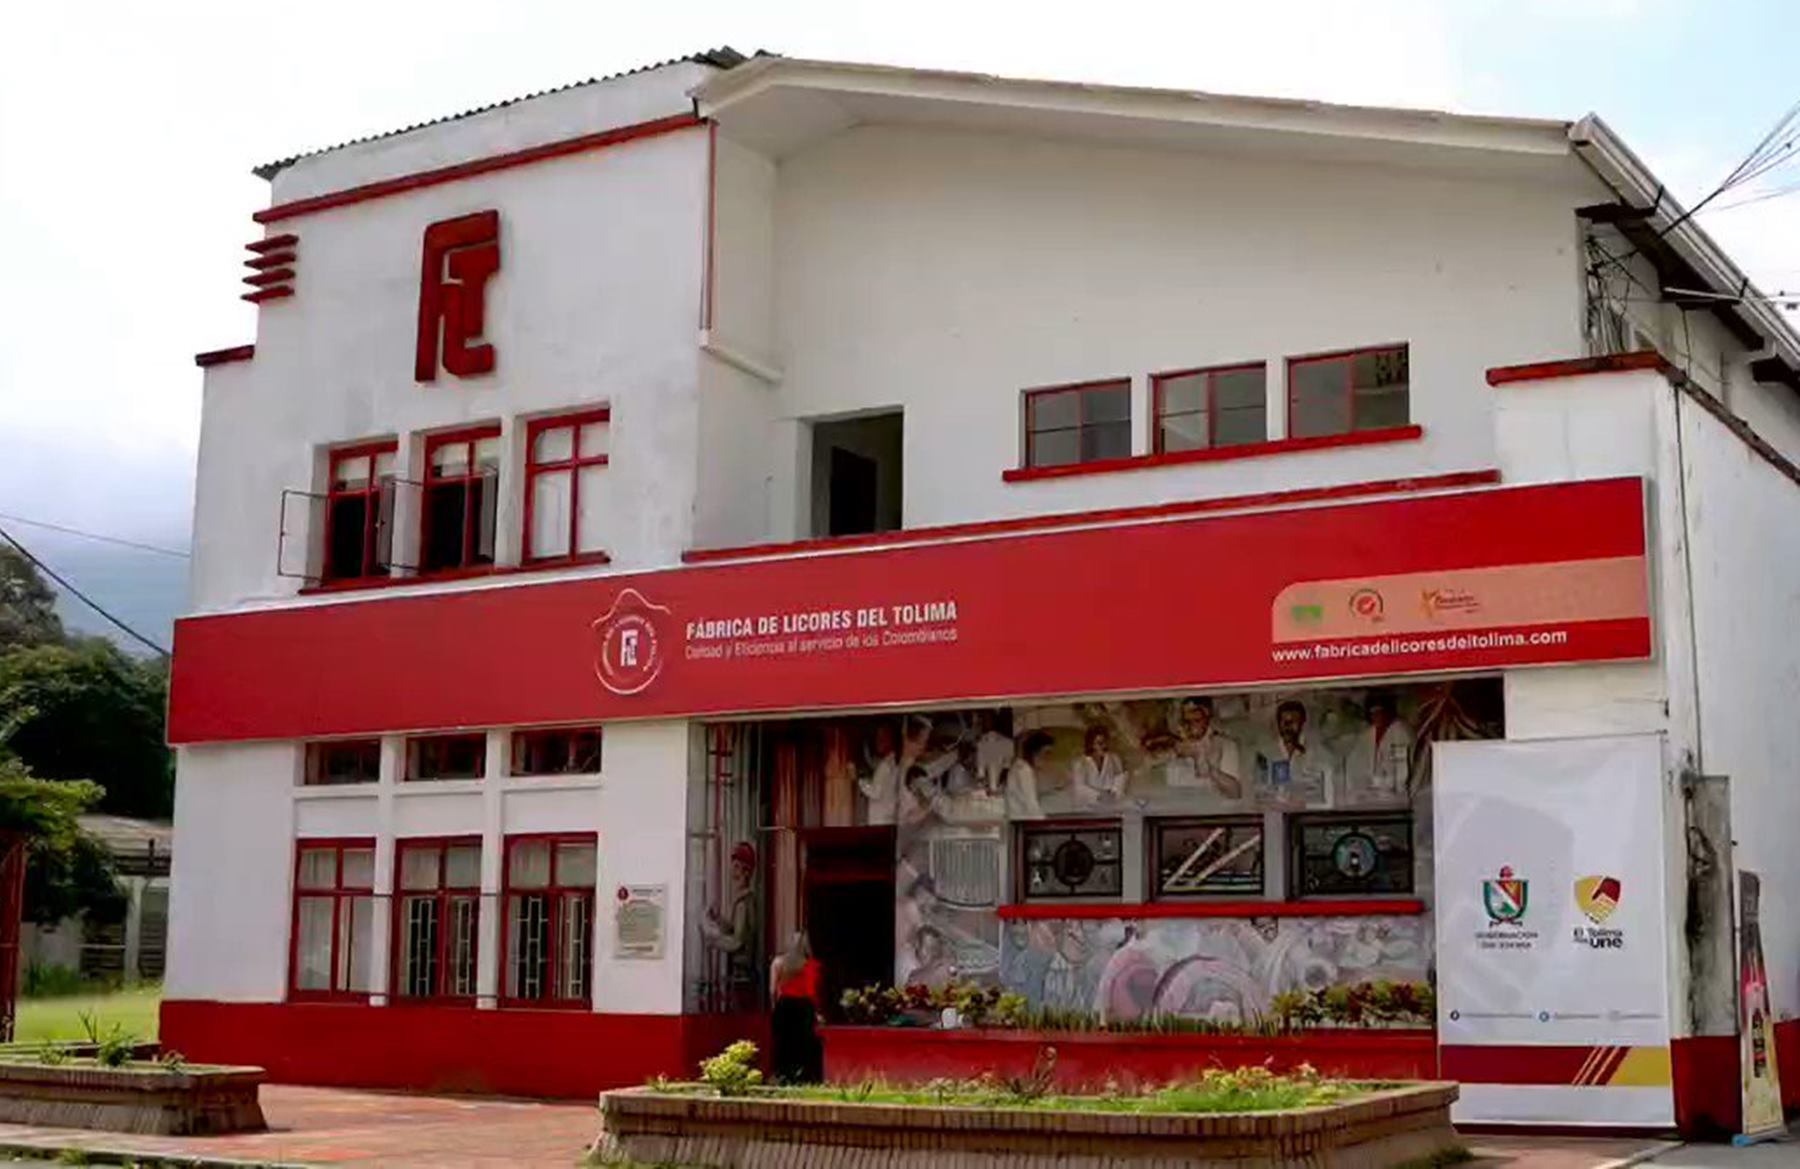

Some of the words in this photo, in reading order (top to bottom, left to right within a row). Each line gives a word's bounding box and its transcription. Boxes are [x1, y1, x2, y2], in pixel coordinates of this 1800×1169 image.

[686, 616, 753, 641] FÁBRICA
[757, 616, 779, 635] DE
[783, 609, 852, 634] LICORES
[856, 607, 889, 628] DEL
[892, 601, 958, 625] TOLIMA
[845, 633, 860, 648] de
